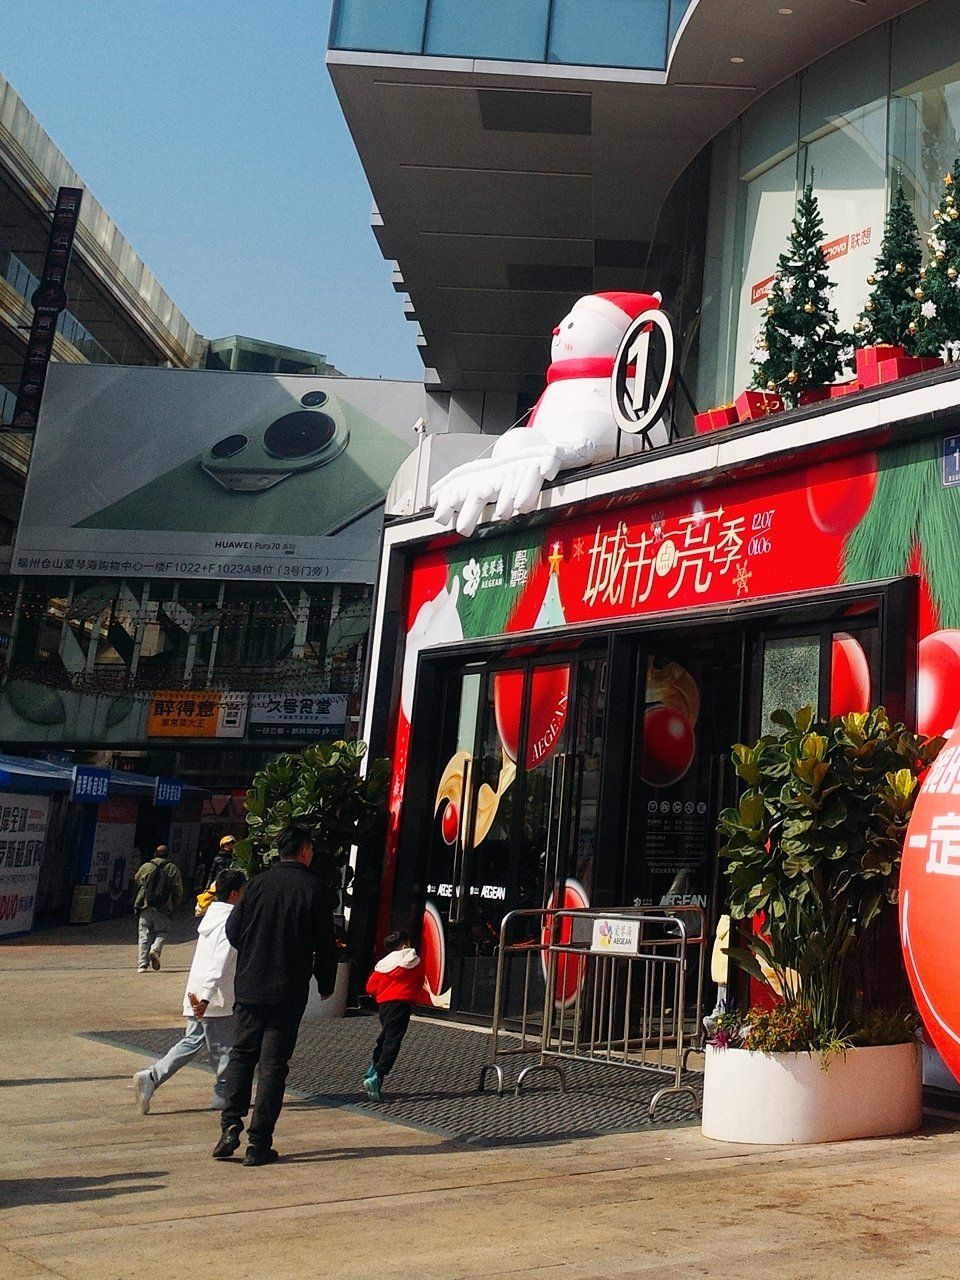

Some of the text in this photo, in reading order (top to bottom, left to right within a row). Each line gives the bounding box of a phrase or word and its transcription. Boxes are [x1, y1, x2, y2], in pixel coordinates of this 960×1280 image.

[850, 227, 872, 250] 联想
[214, 541, 252, 550] HUAWEI
[582, 506, 747, 608] 城市点亮季
[481, 559, 504, 578] 爱琴海
[481, 578, 503, 589] AEGEAN
[532, 691, 568, 762] AEGEAN
[437, 883, 461, 898] AEGEN
[480, 885, 506, 900] AEGEAN
[613, 937, 633, 945] AEGEAN
